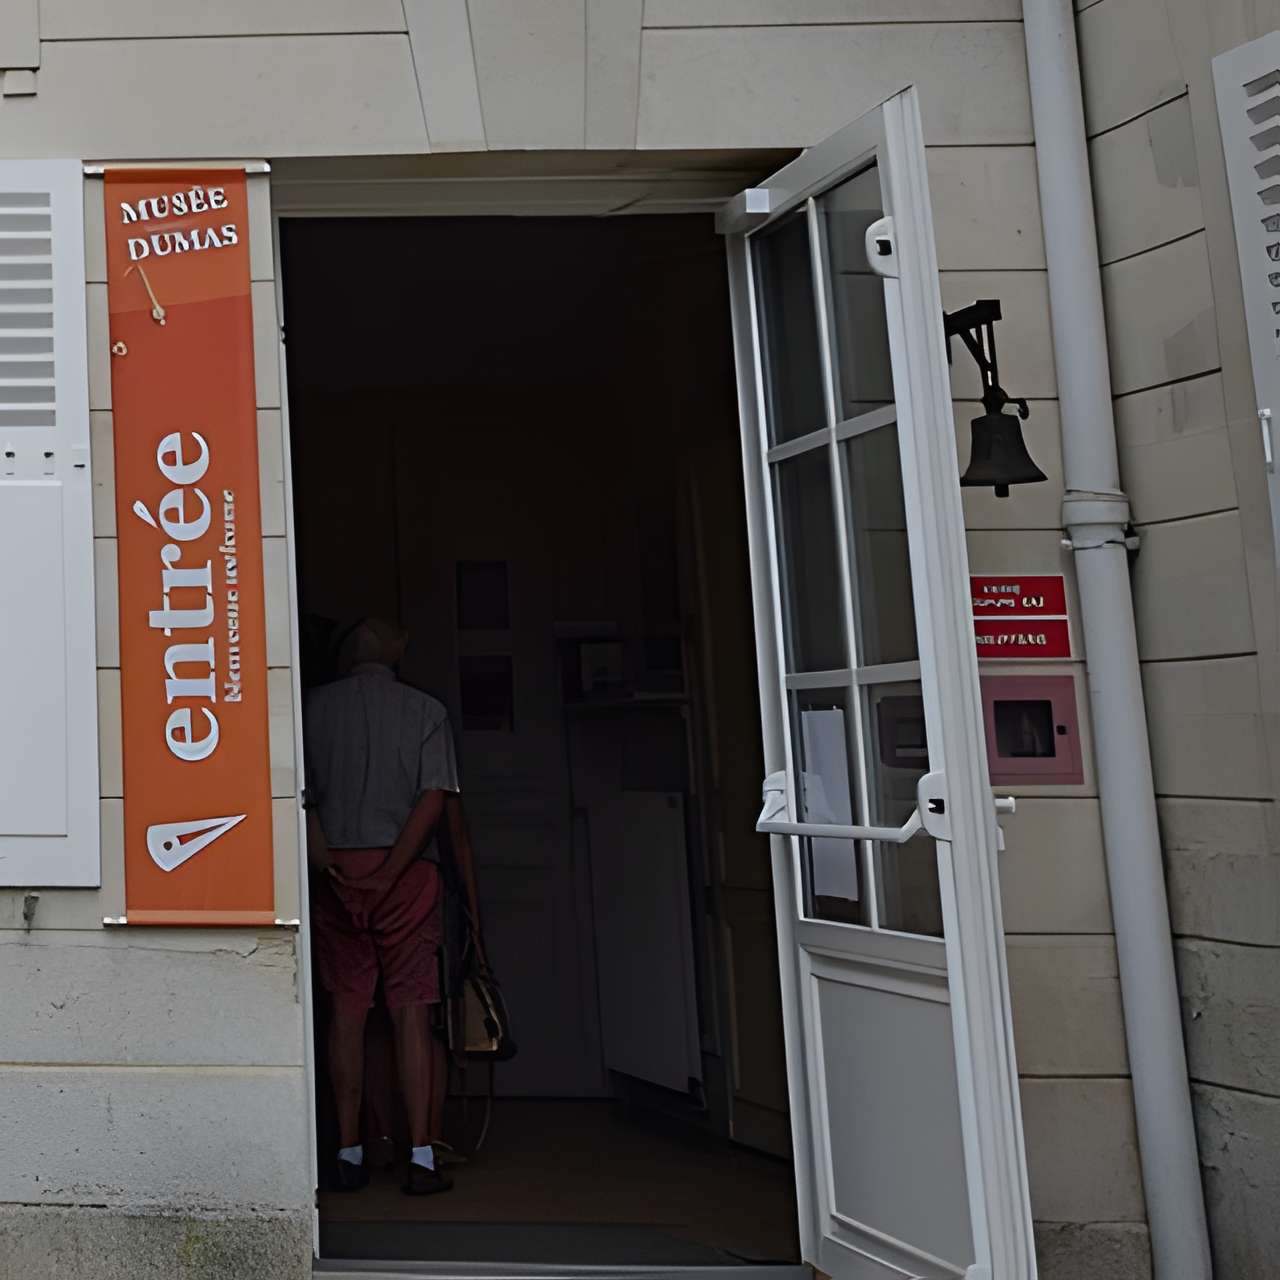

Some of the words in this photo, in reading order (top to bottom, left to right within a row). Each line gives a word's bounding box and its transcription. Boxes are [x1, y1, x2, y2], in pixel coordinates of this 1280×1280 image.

[120, 185, 228, 224] MUSÉE
[127, 223, 238, 261] DUMAS
[132, 431, 220, 761] entrée
